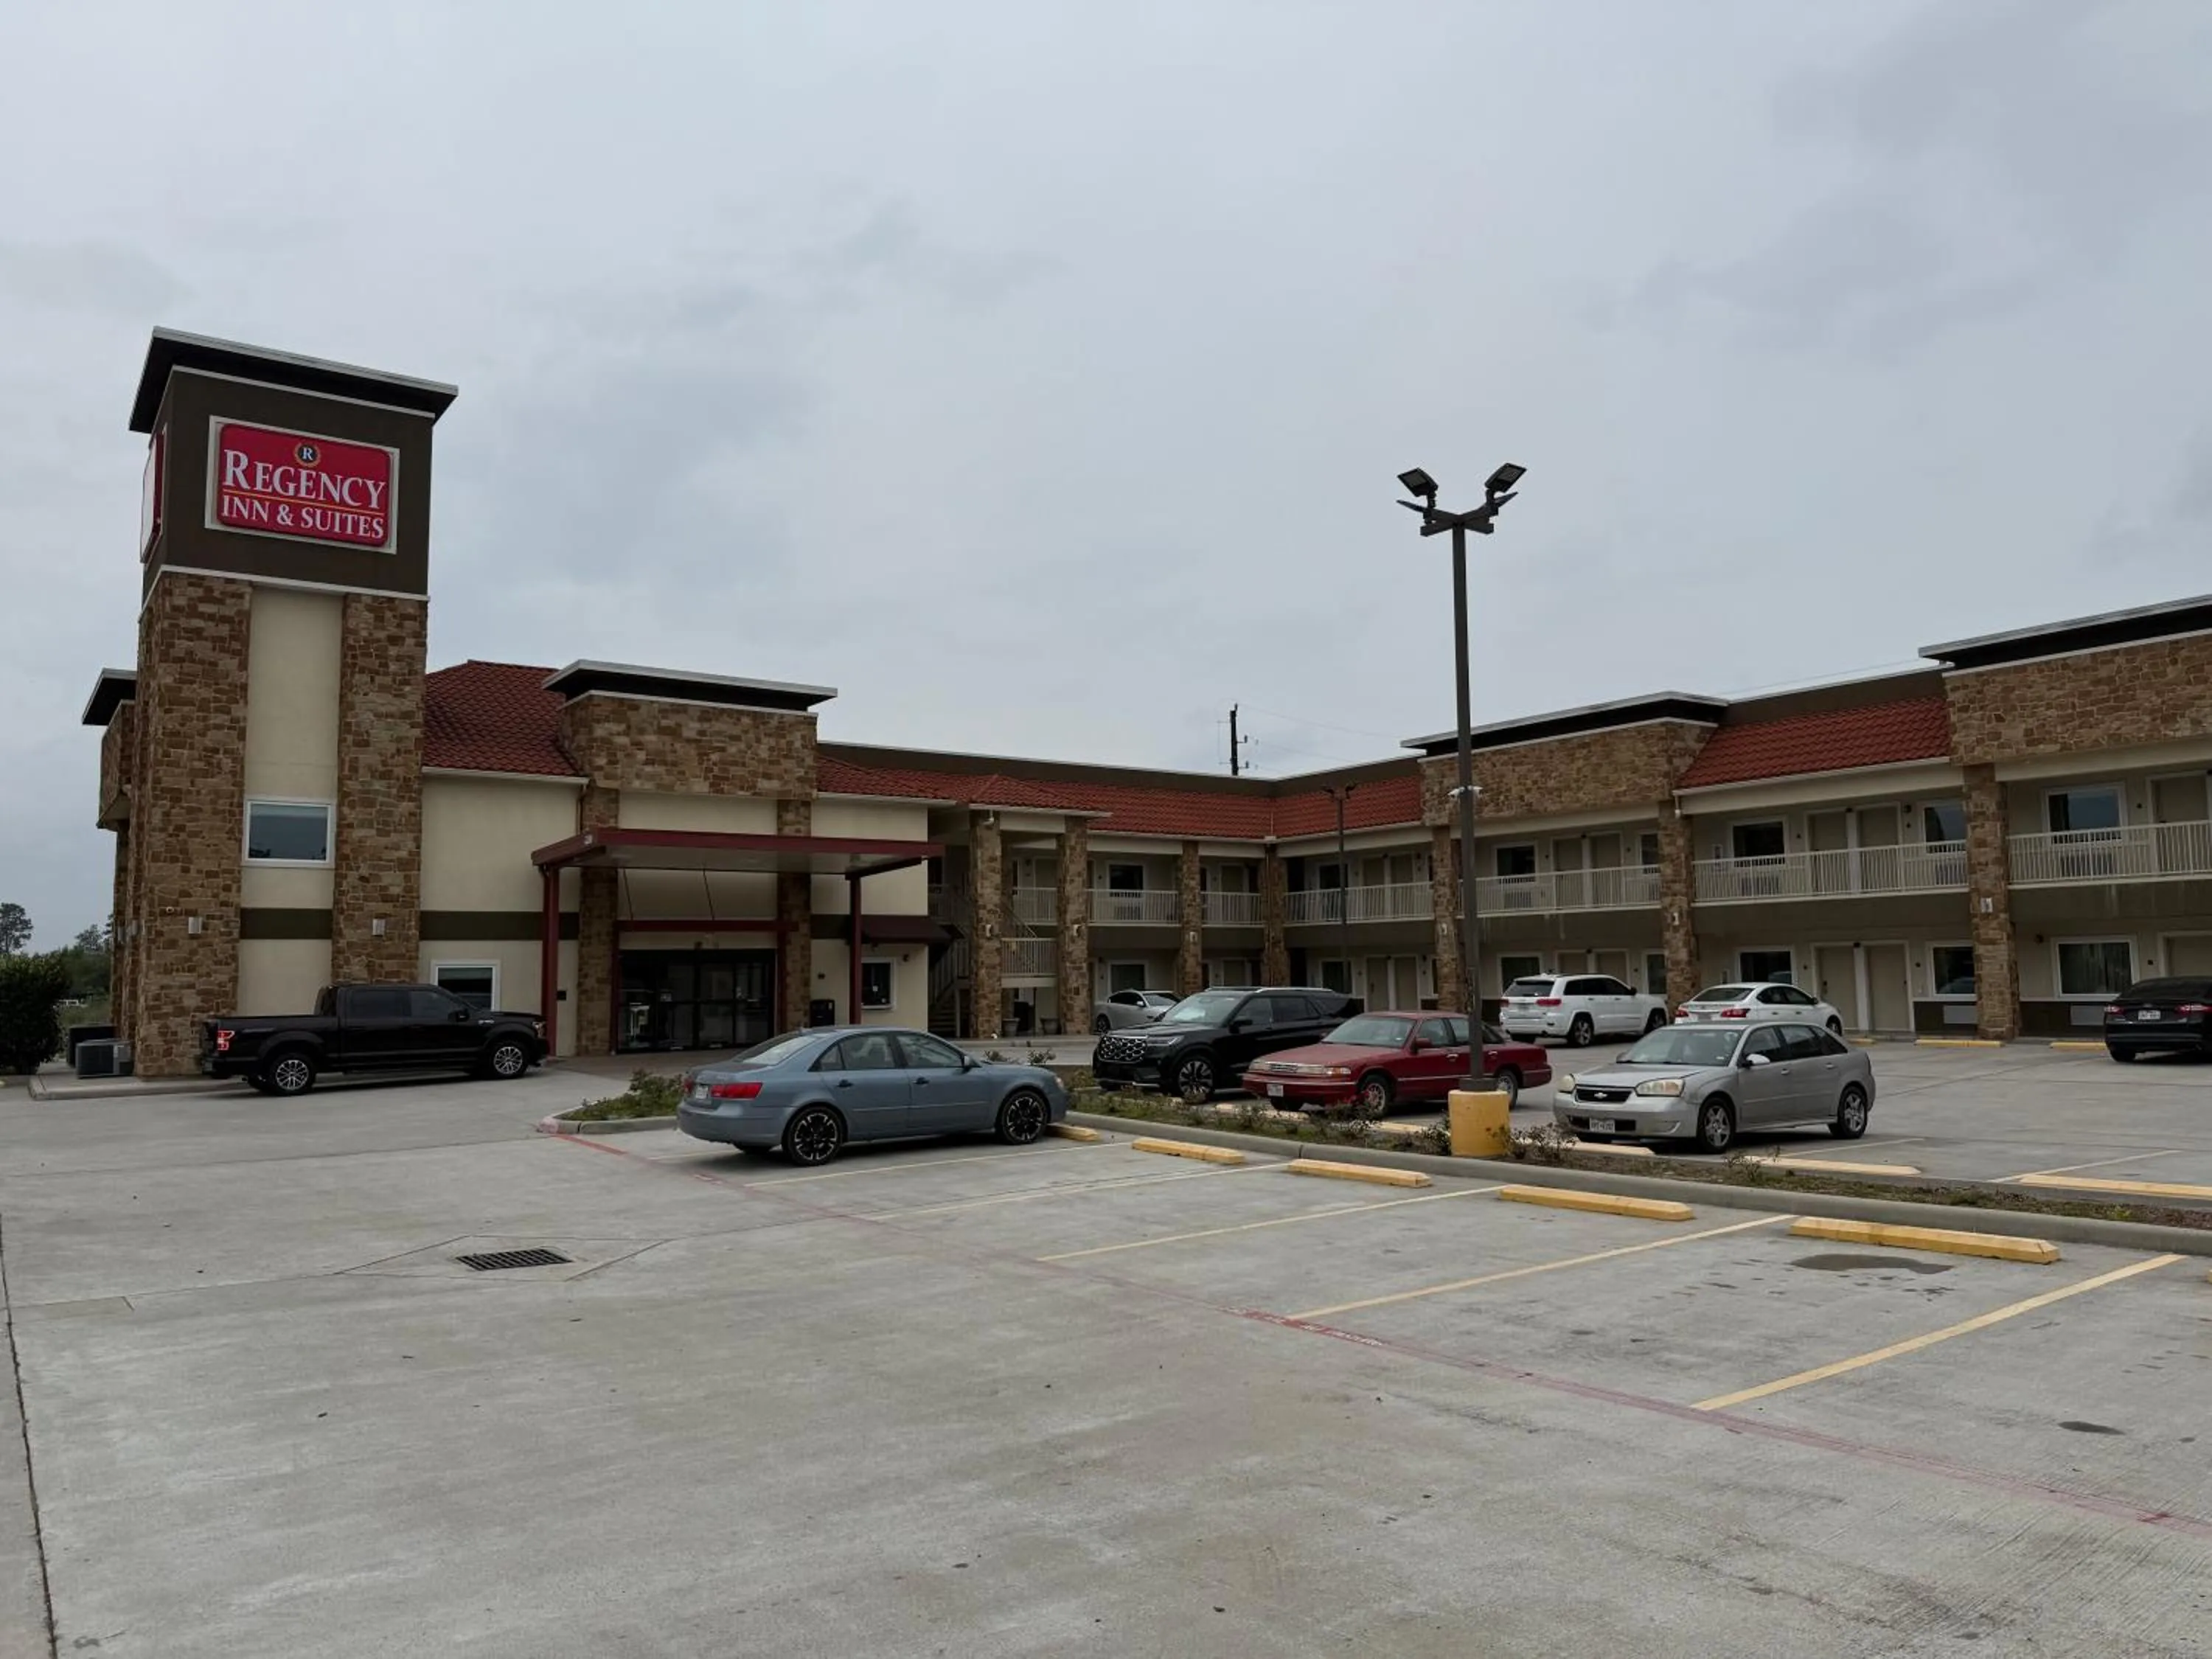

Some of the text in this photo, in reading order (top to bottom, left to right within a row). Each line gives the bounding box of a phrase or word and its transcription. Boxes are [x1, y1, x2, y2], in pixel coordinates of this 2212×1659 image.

[302, 447, 313, 461] R
[223, 449, 386, 509] REGENCY
[221, 495, 384, 539] INN & SUITES
